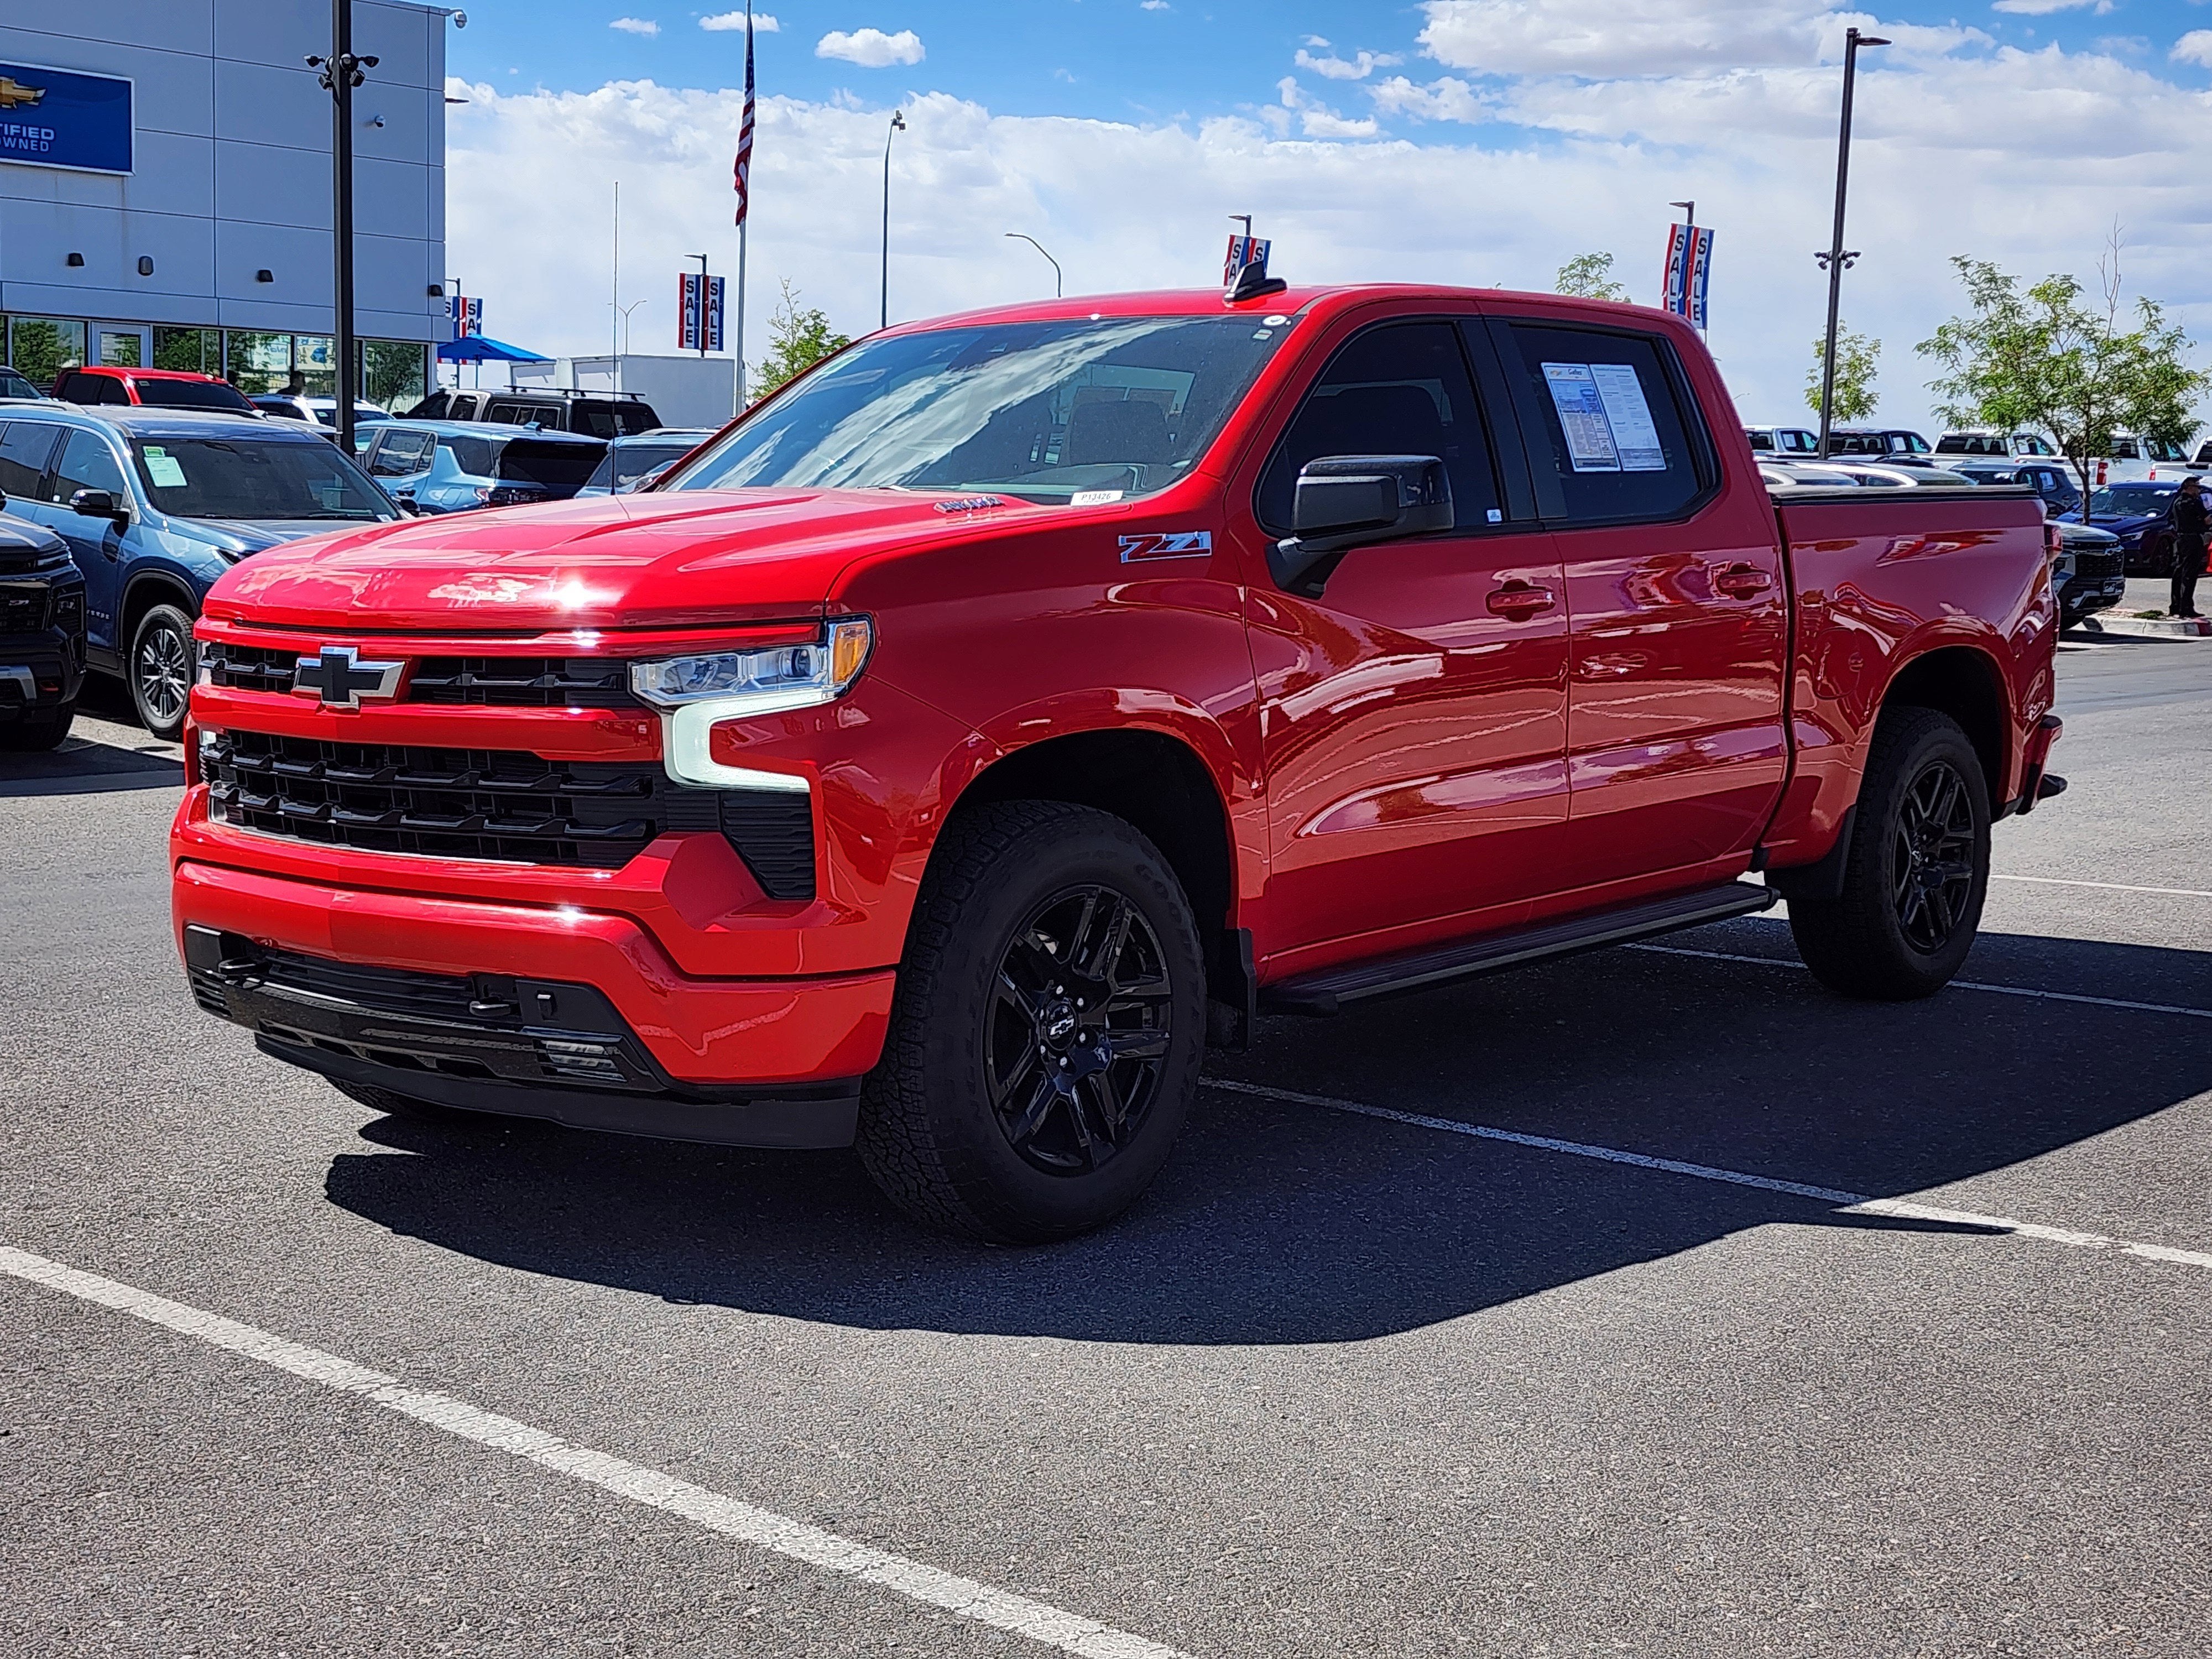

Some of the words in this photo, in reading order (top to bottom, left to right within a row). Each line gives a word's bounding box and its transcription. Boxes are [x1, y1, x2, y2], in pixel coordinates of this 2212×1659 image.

[0, 123, 54, 140] IFIED
[0, 137, 49, 152] WNED
[1670, 234, 1684, 312] SALE
[1693, 237, 1707, 321] SALE
[467, 303, 476, 336] SA
[685, 280, 694, 343] SALE
[709, 283, 718, 345] SALE
[1118, 531, 1212, 563] Z71
